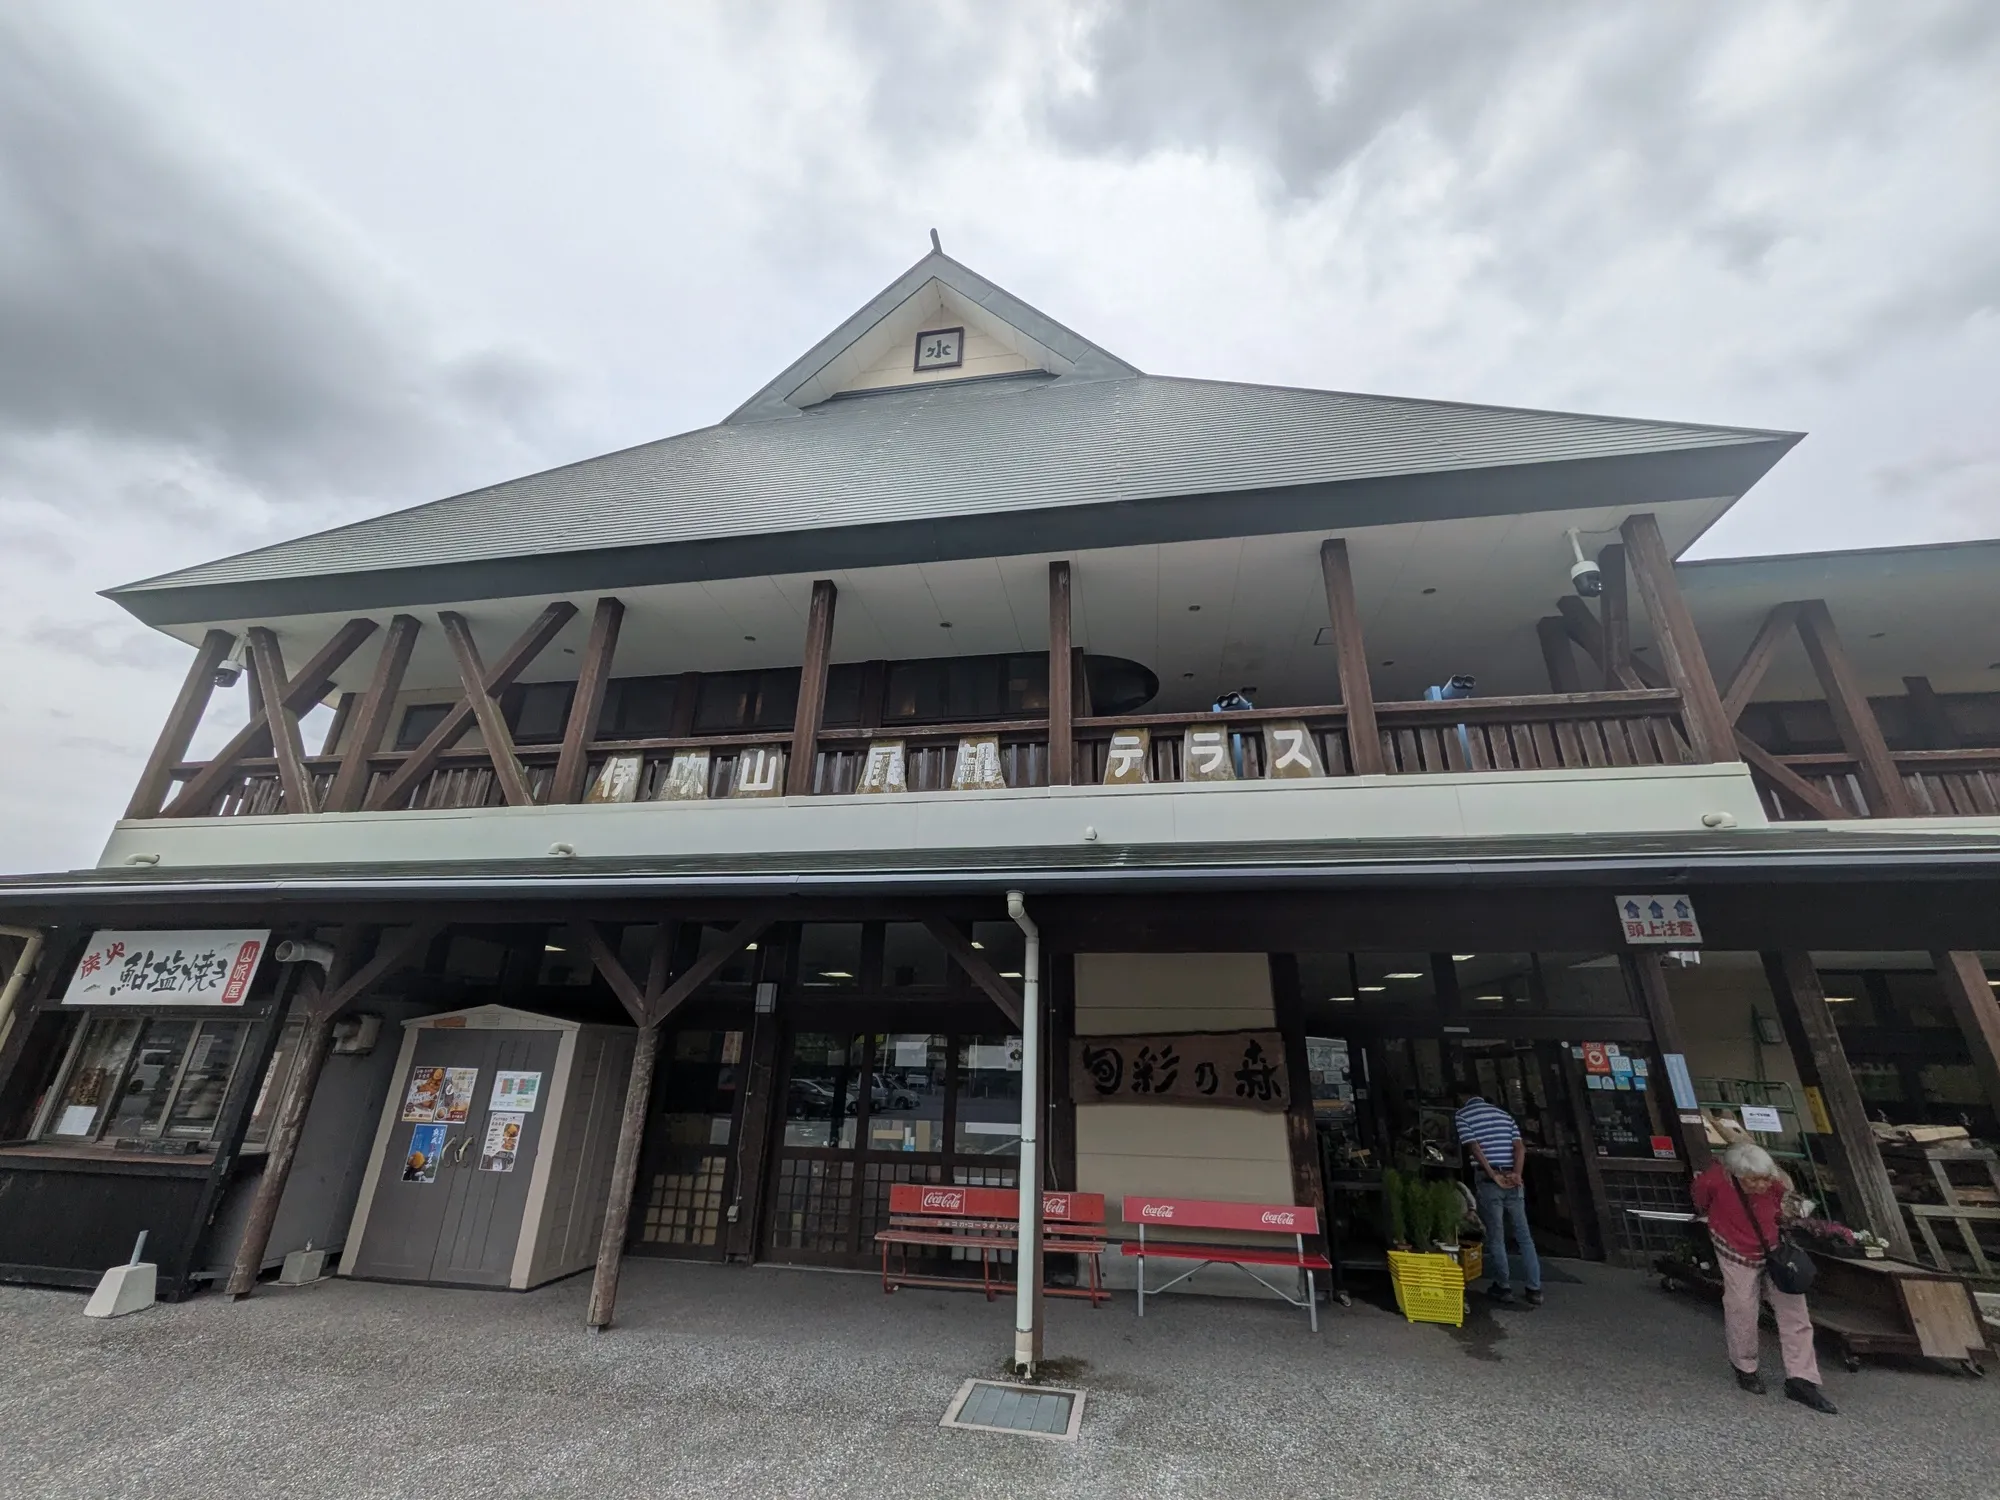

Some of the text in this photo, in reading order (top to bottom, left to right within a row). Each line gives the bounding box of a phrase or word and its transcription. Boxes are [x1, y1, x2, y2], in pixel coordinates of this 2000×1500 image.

[925, 339, 952, 359] 水
[1109, 729, 1312, 778] テラス
[1625, 920, 1696, 938] 頭上注意
[109, 949, 228, 996] 鮎塩焼き
